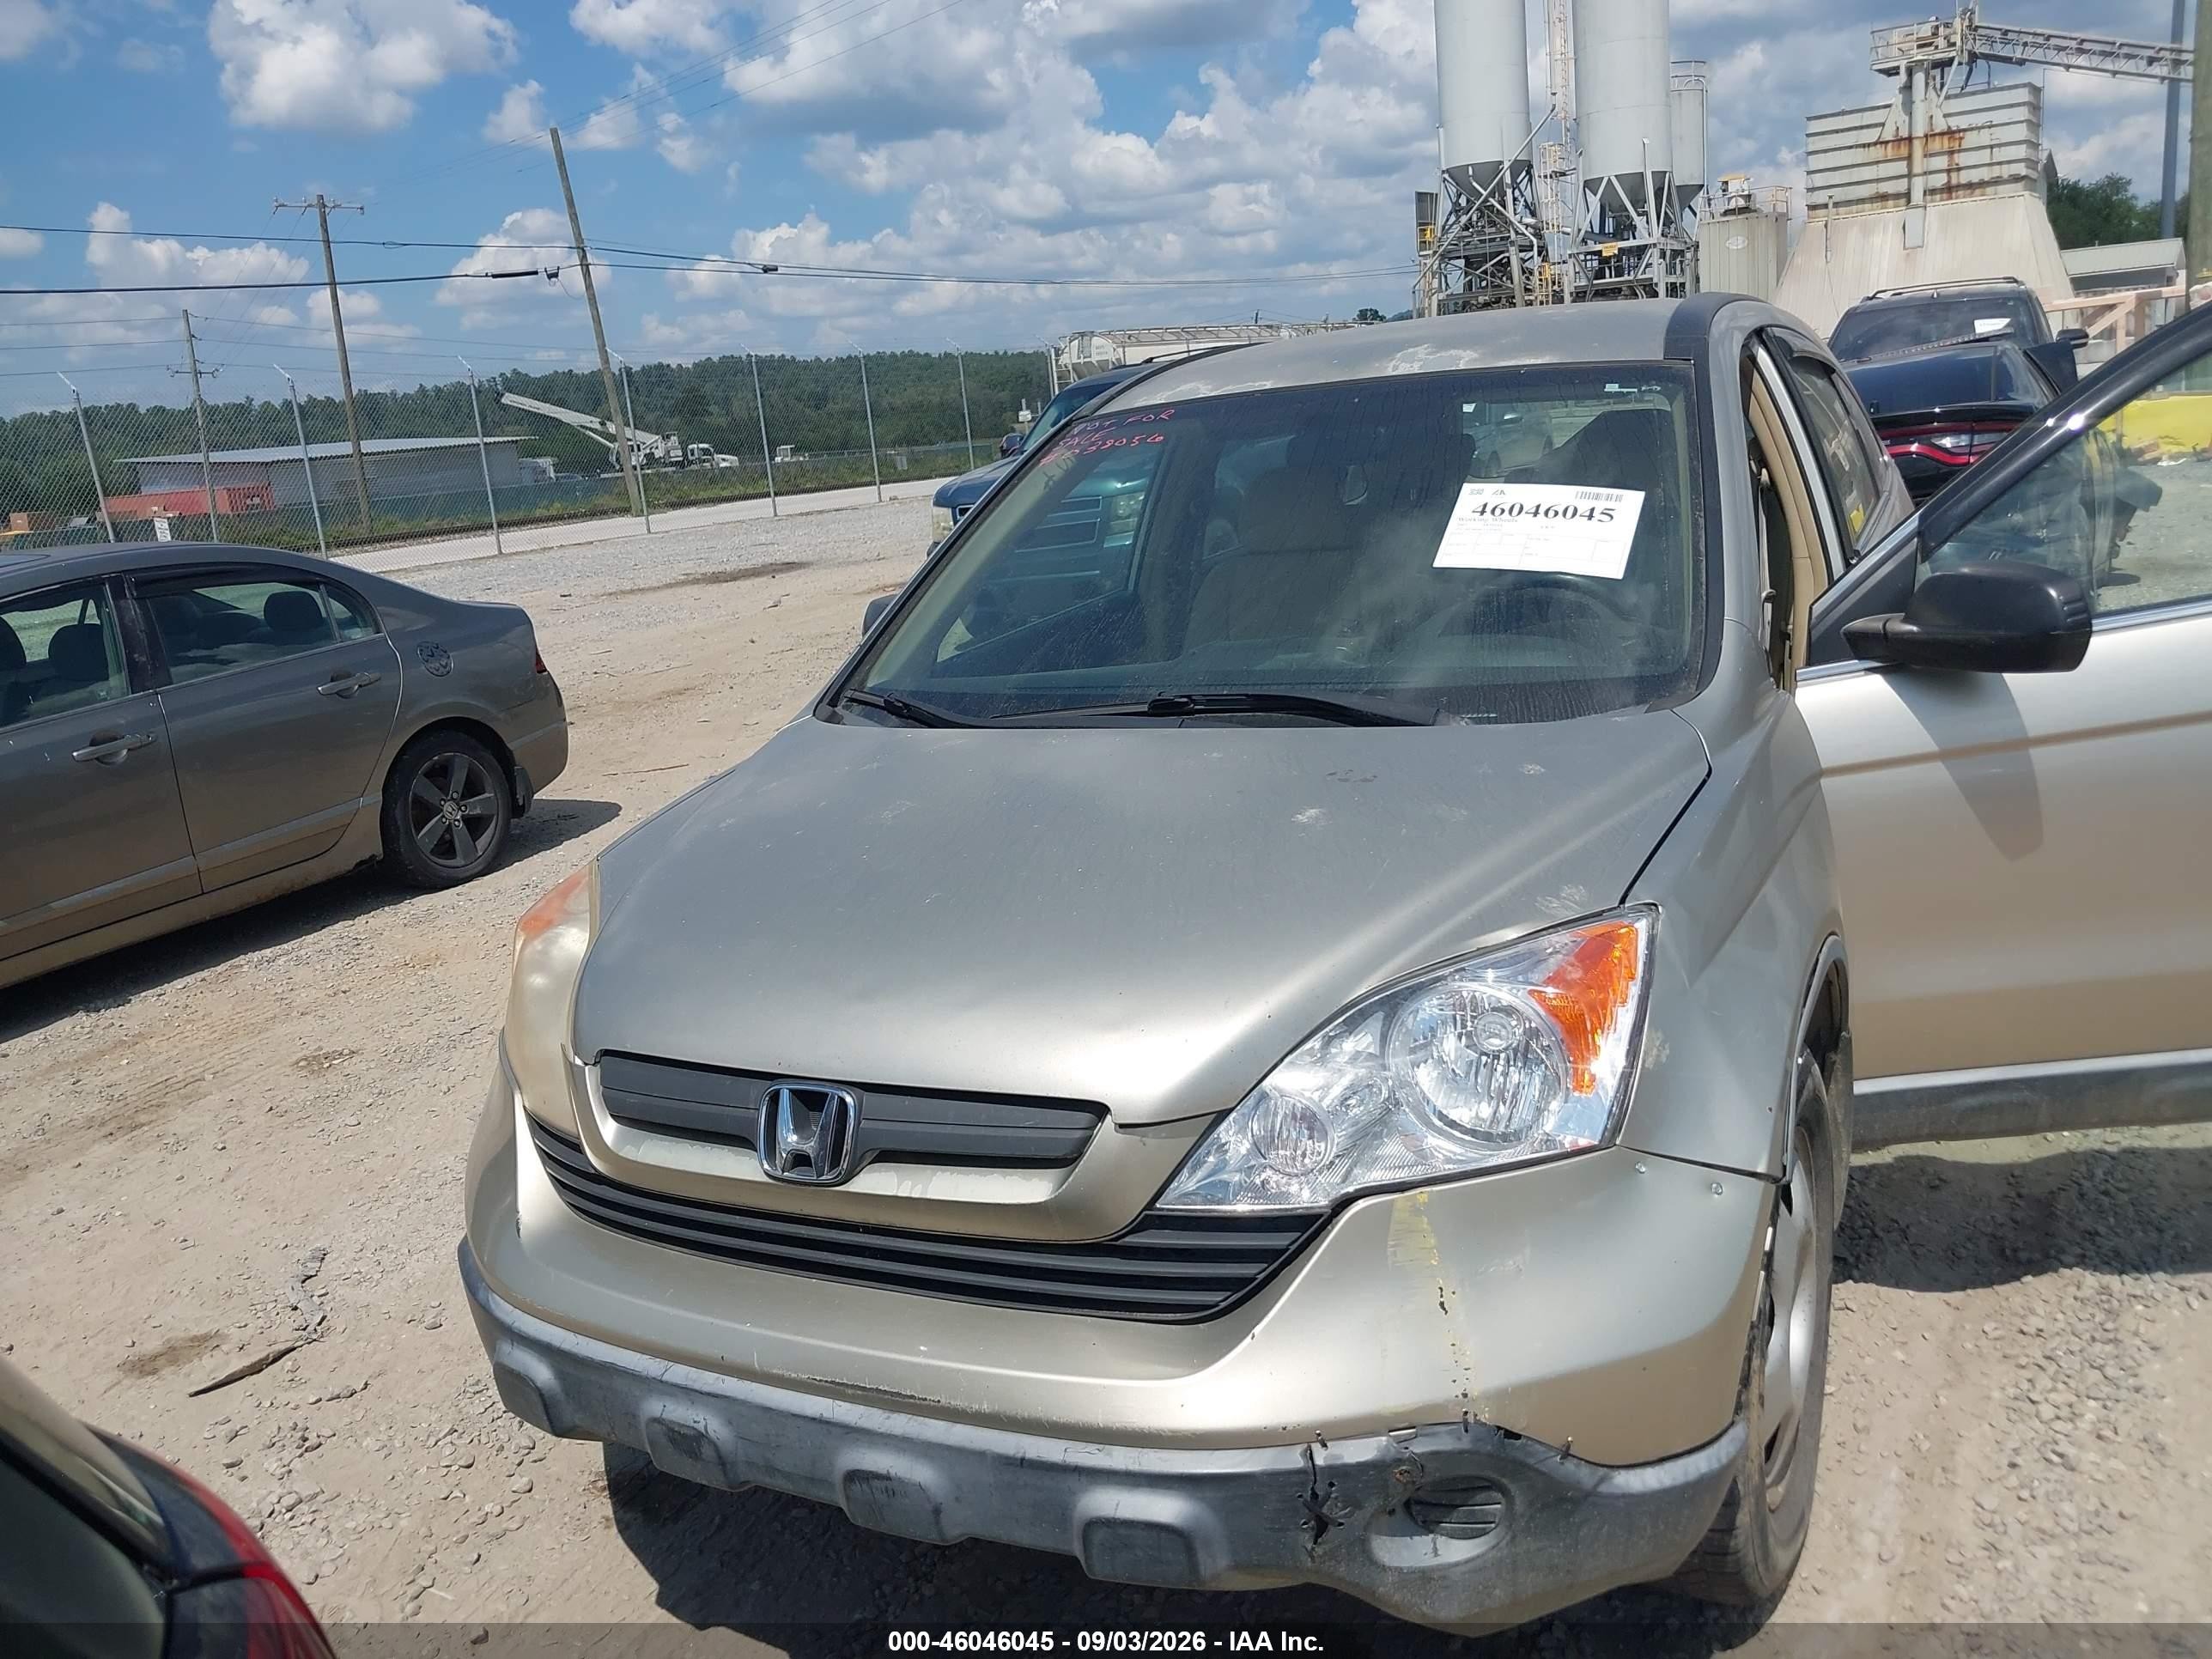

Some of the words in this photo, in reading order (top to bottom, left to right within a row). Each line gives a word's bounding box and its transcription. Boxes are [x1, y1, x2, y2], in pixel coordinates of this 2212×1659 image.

[1124, 409, 1176, 426] FOR
[1053, 427, 1117, 451] SALE
[1471, 501, 1617, 523] 46046045
